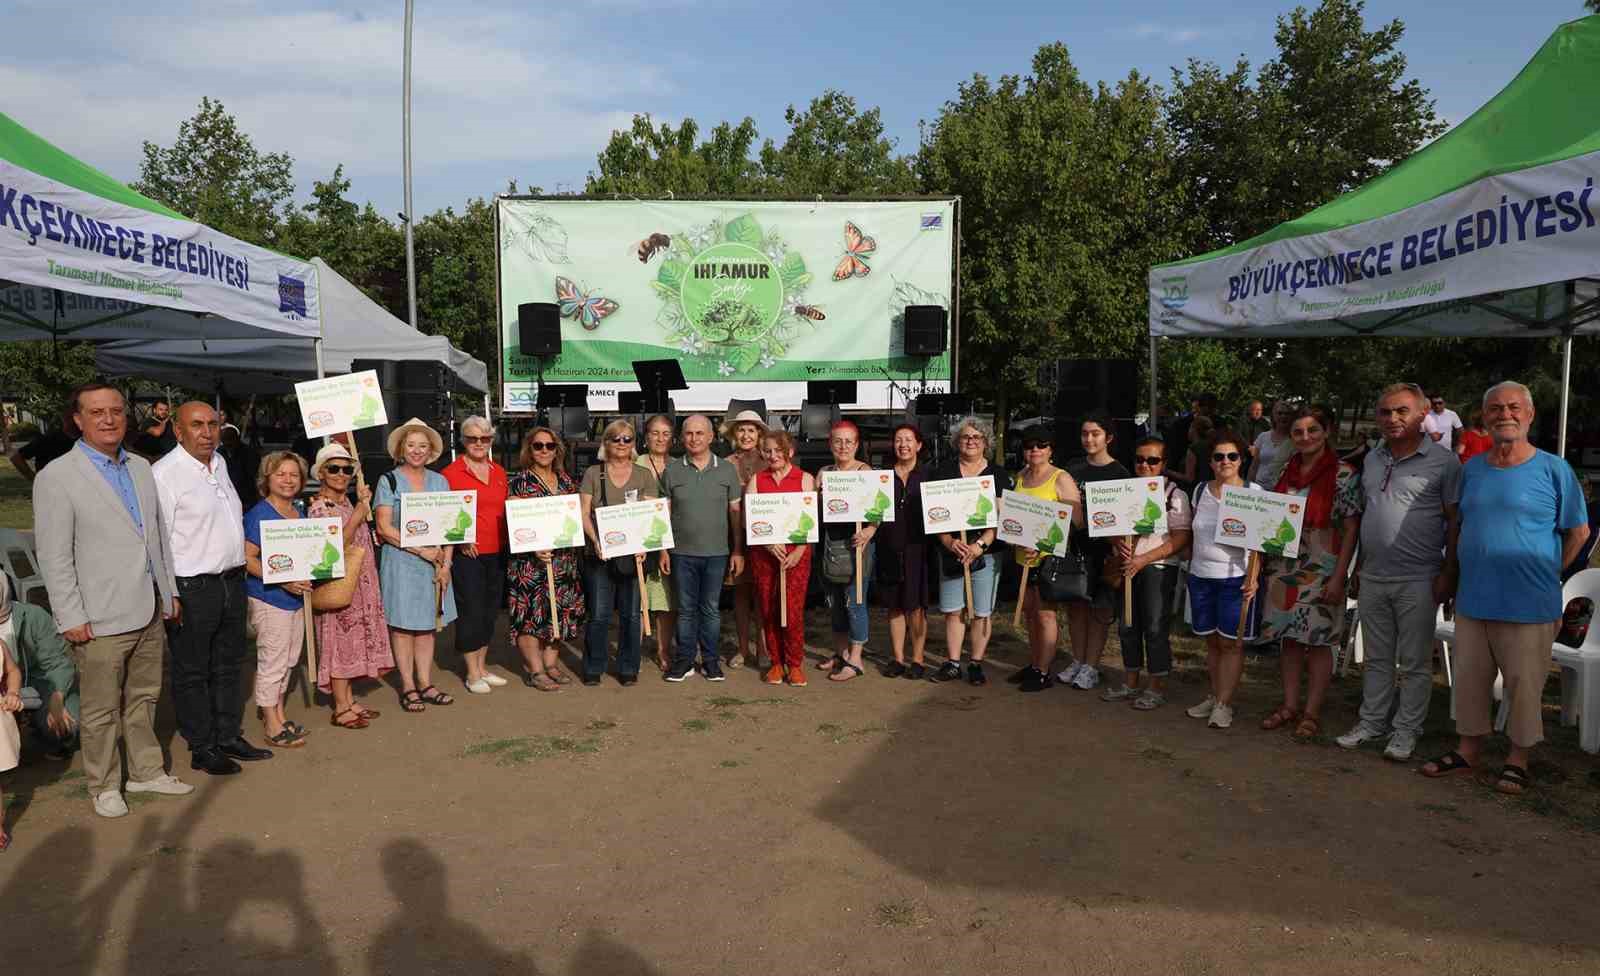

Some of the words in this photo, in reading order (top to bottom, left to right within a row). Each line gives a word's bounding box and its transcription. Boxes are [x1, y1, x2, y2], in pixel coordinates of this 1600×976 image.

[1401, 176, 1596, 272] BELEDİYESİ
[151, 233, 250, 291] BELEDİYESİ
[693, 263, 770, 280] IHLAMUR
[587, 367, 609, 377] 2024
